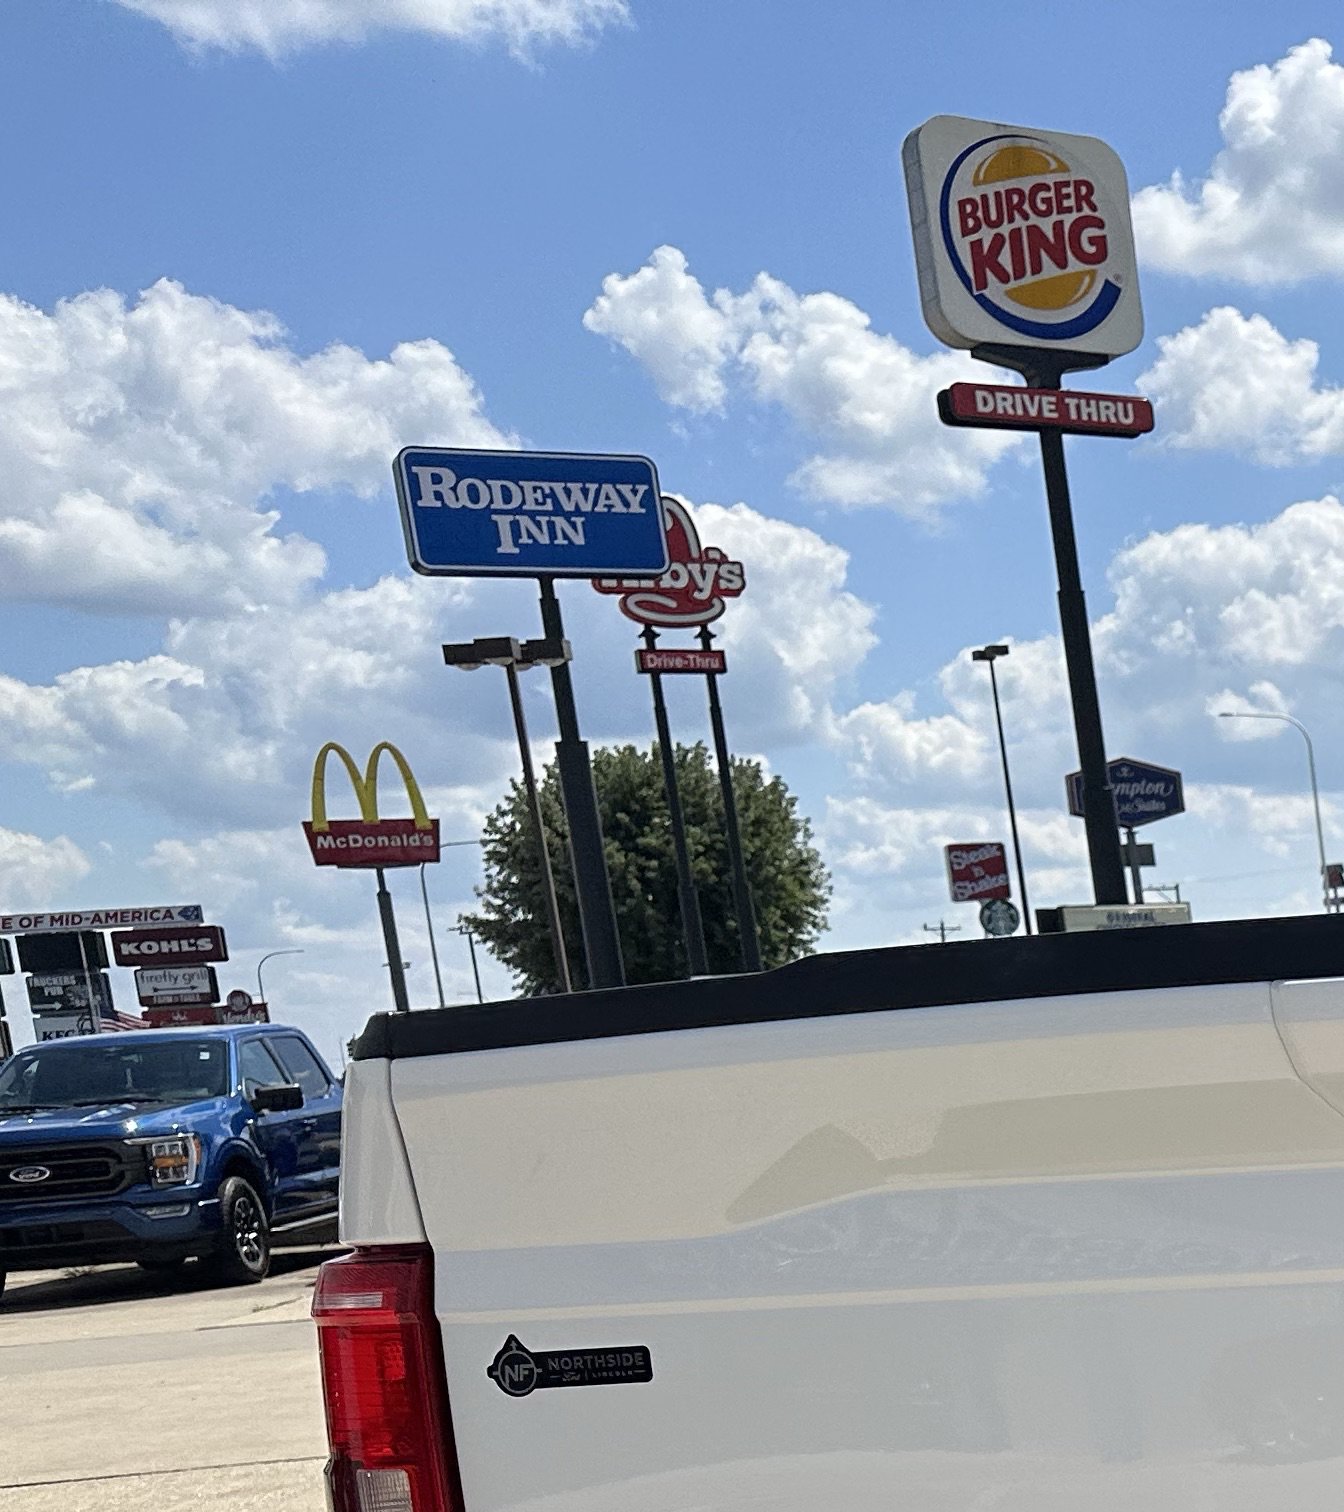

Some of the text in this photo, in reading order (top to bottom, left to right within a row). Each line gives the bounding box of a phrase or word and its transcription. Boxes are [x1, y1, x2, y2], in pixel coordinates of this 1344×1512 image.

[957, 179, 1098, 239] BURGER
[969, 215, 1108, 291] KING
[975, 389, 1134, 425] DRIVE THRU
[491, 514, 586, 554] INN
[645, 653, 720, 670] Drive-Thru
[316, 833, 434, 850] McDonald's
[18, 915, 44, 929] OF
[49, 909, 175, 928] MID-AMERICA
[119, 938, 214, 955] KOHL'S
[547, 1352, 645, 1371] NORTHSIDE
